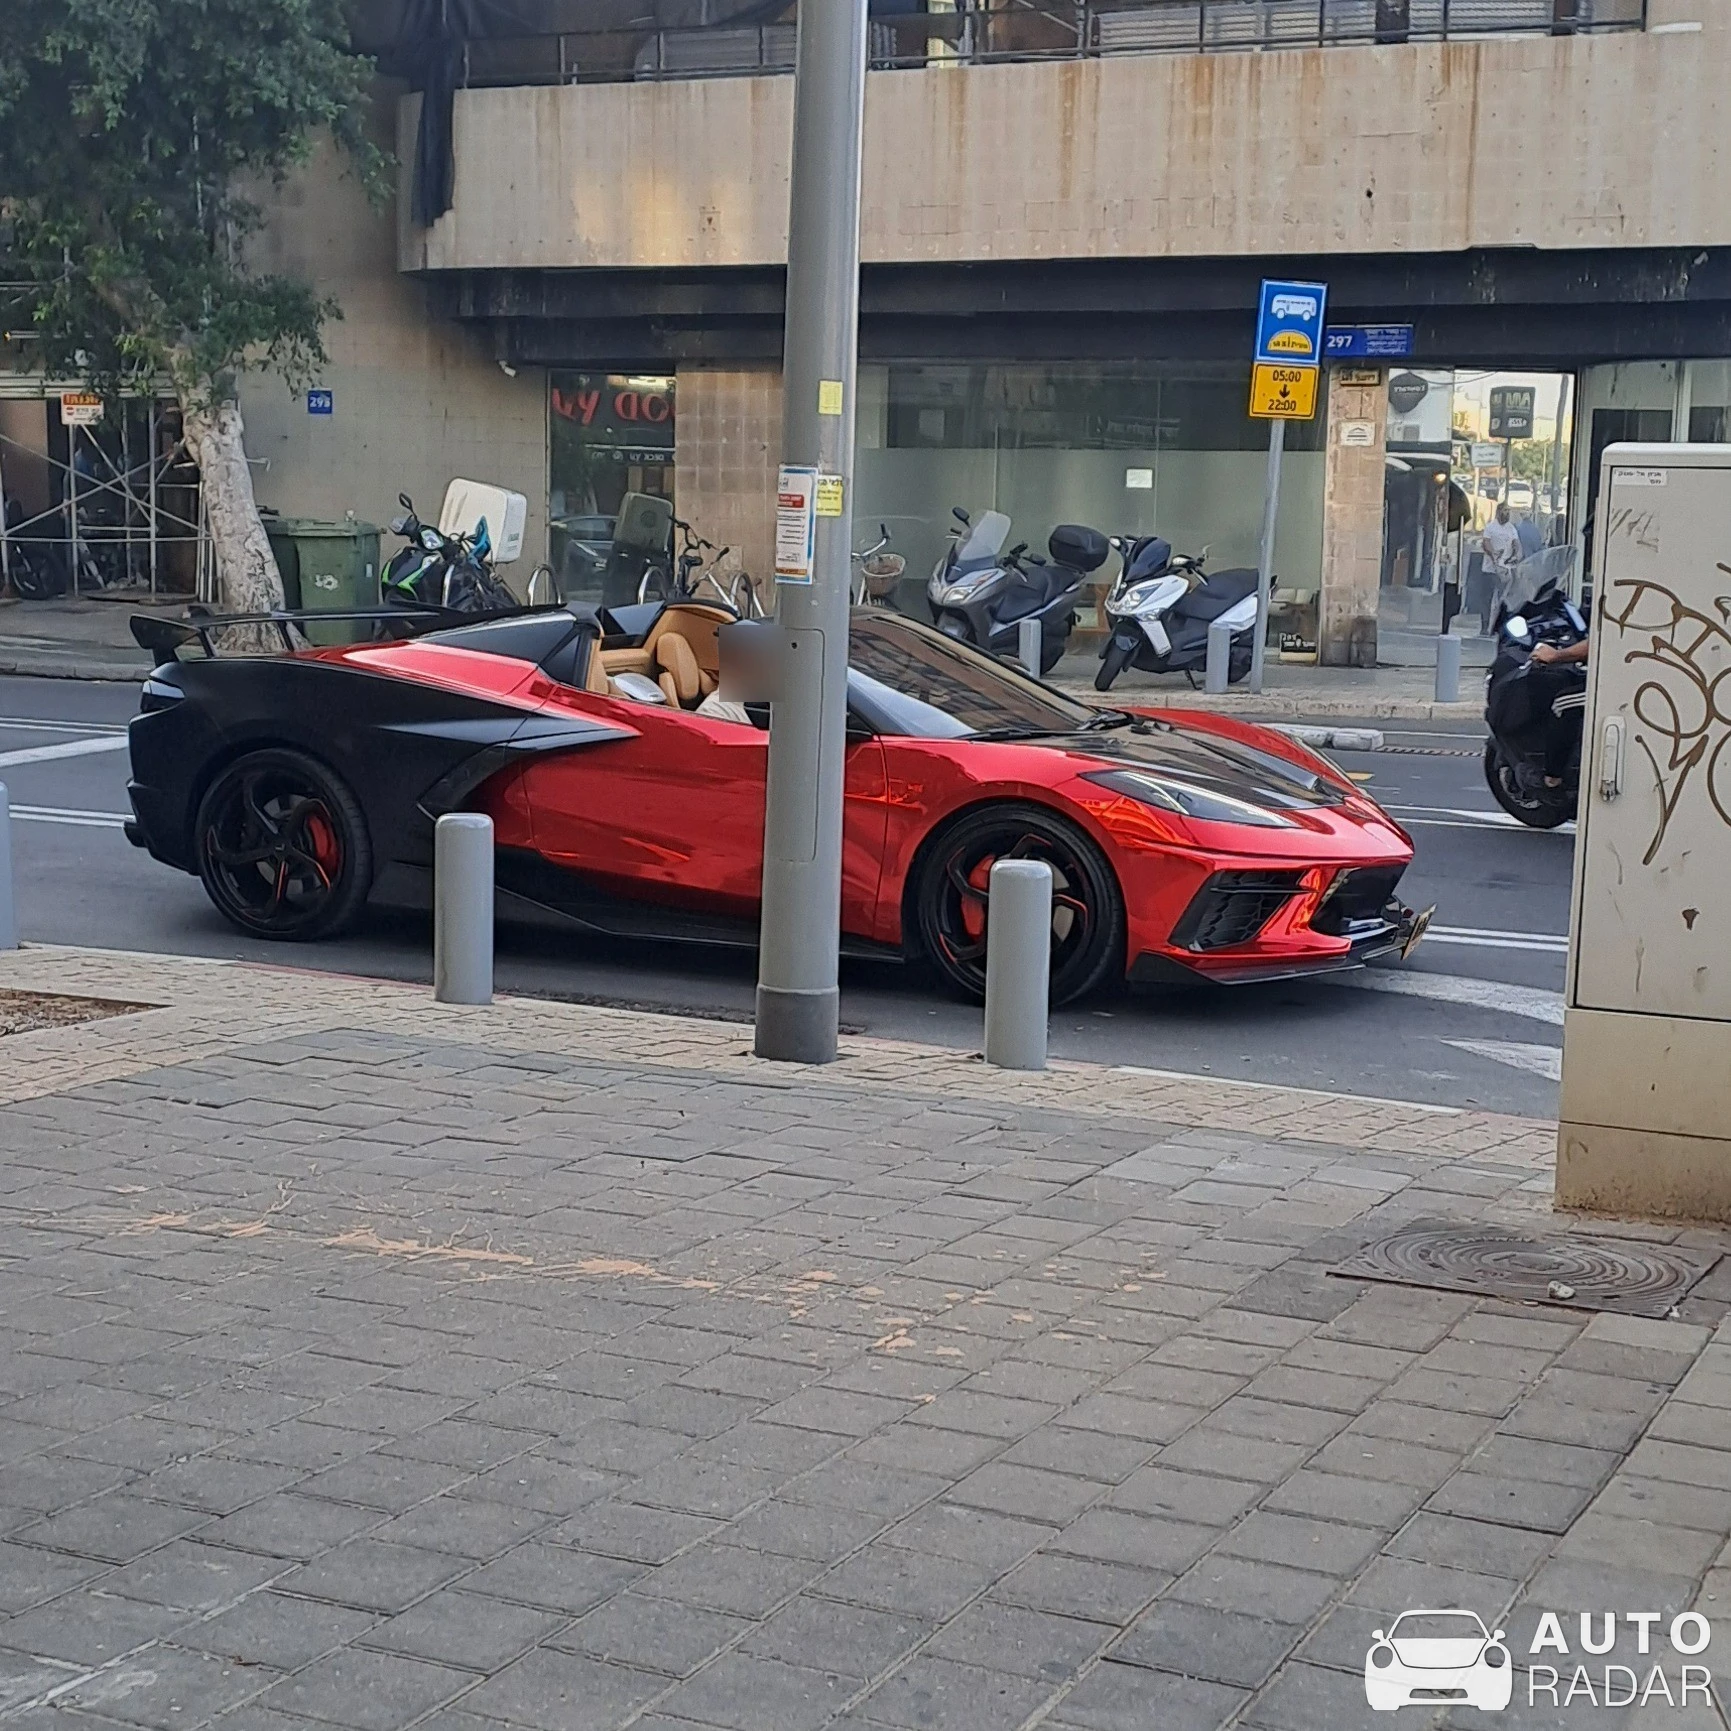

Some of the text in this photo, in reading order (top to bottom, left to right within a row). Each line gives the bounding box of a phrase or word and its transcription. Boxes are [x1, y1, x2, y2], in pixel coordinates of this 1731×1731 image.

[1327, 335, 1353, 348] 297
[1272, 369, 1302, 383] 05:00
[1267, 398, 1297, 412] 22:00
